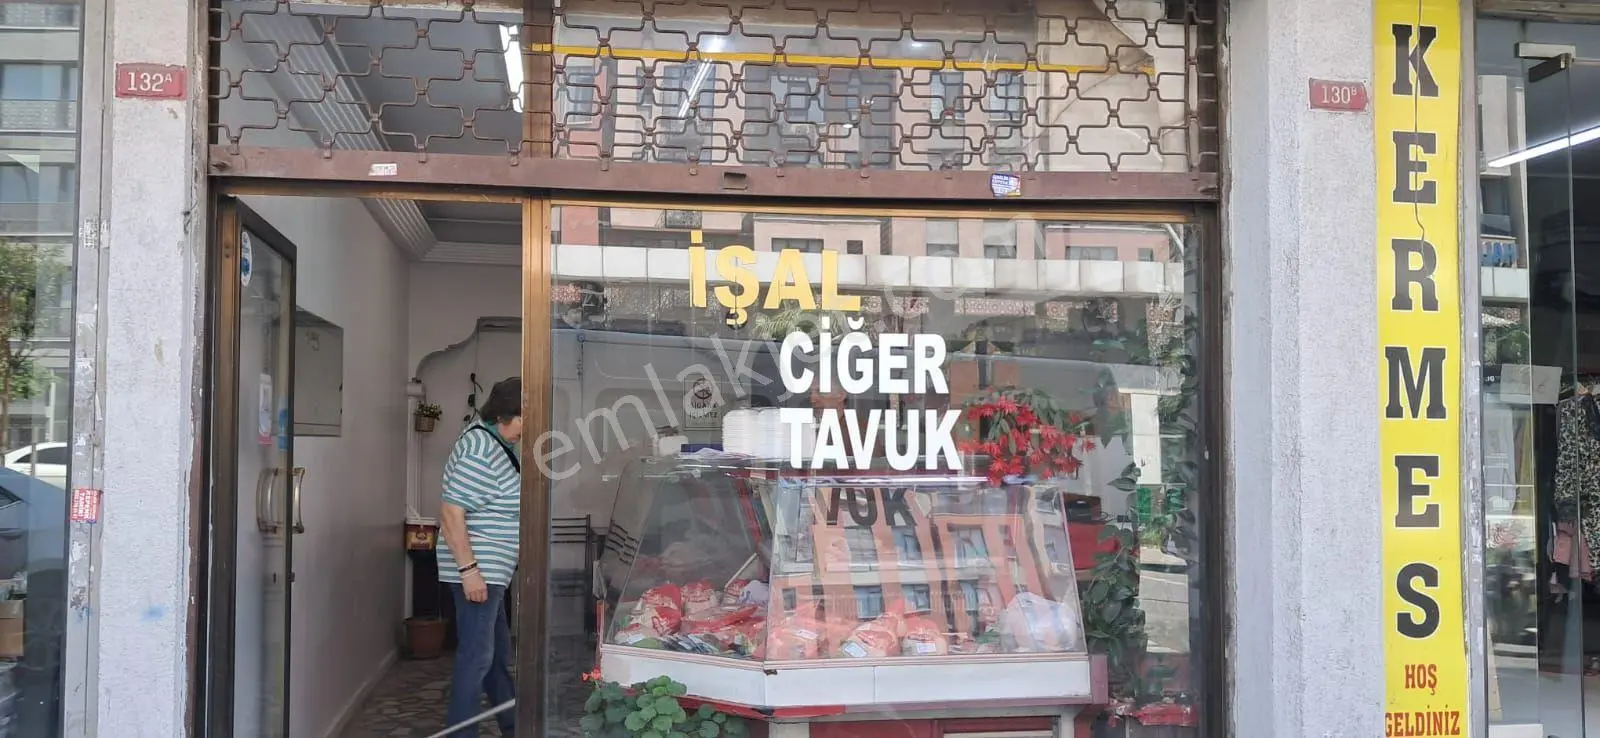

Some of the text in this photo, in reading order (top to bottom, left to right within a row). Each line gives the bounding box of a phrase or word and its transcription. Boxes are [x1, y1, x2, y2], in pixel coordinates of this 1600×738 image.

[688, 230, 861, 326] İŞAL
[779, 316, 949, 394] CİĞER
[1385, 24, 1446, 639] KERMES
[779, 407, 963, 471] TAVUK
[1404, 663, 1438, 696] HOŞ
[1384, 703, 1461, 737] GELDİNİZ
